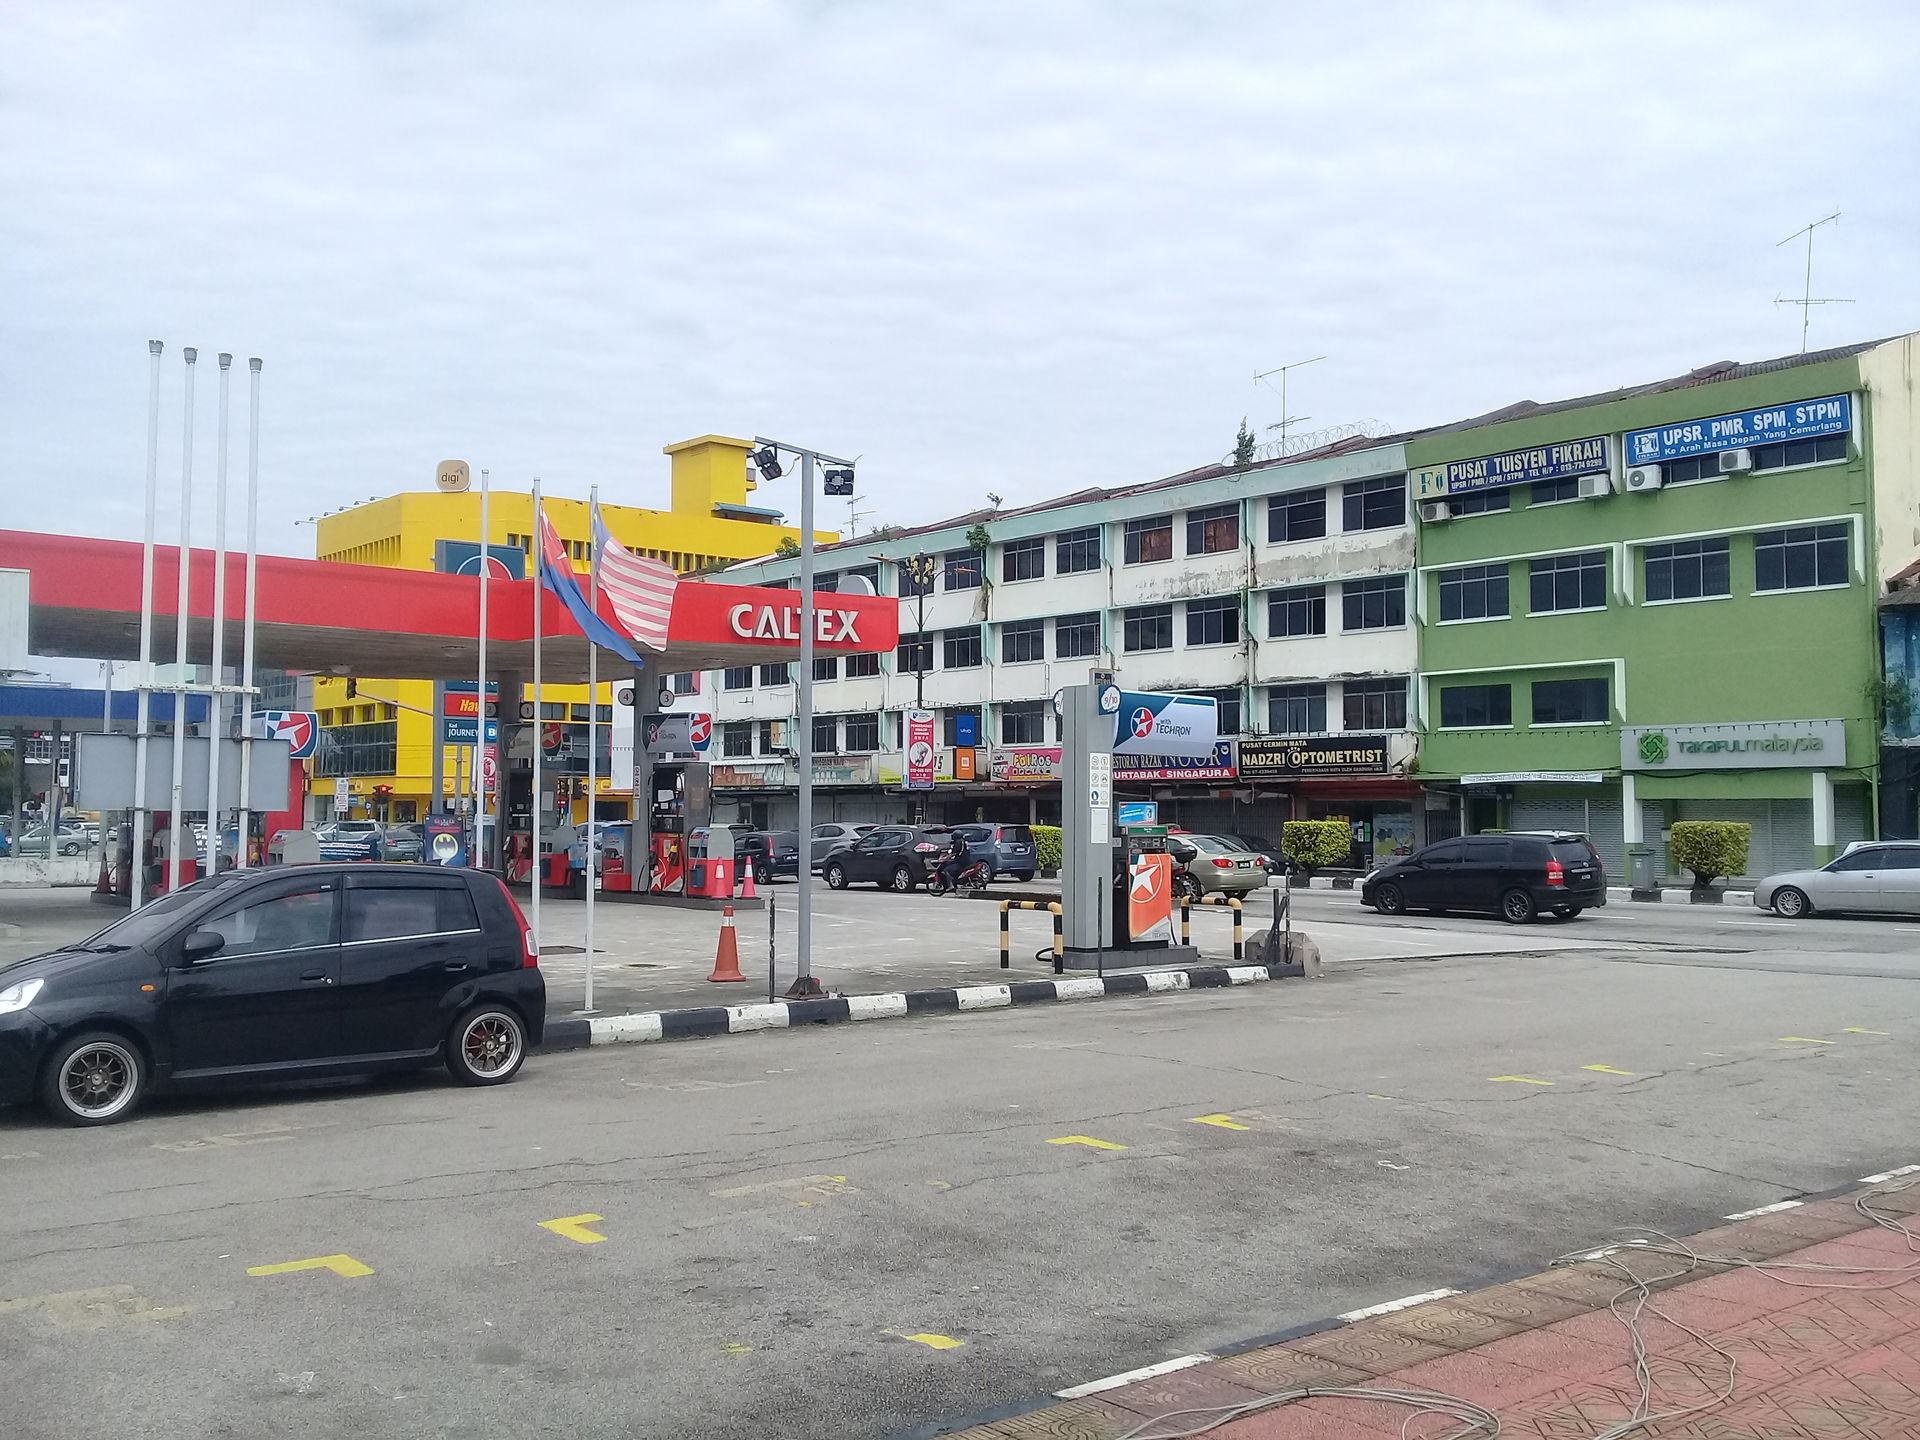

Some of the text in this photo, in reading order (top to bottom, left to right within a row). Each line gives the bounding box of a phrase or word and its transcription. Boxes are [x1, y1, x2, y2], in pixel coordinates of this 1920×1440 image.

[1663, 401, 1841, 446] UPSR, PMR, SPM, STPM
[1664, 421, 1842, 456] Ke Arah Masa Depan Yang Cemerlang
[1450, 440, 1602, 482] PUSAT TUISYEN FIKRAH
[441, 472, 459, 485] digi
[1506, 471, 1525, 481] STPM
[1528, 469, 1540, 477] TEL
[731, 603, 862, 643] CALEX
[1104, 692, 1118, 707] 9/10
[448, 728, 479, 738] JOURNEY
[1155, 723, 1192, 737] TECHRON
[1241, 741, 1262, 749] PUSAT
[1263, 740, 1288, 748] CERMIN
[1242, 749, 1383, 766] NADZRI OPTOMETRIST
[1112, 769, 1230, 779] URTABAK SINGAPURA
